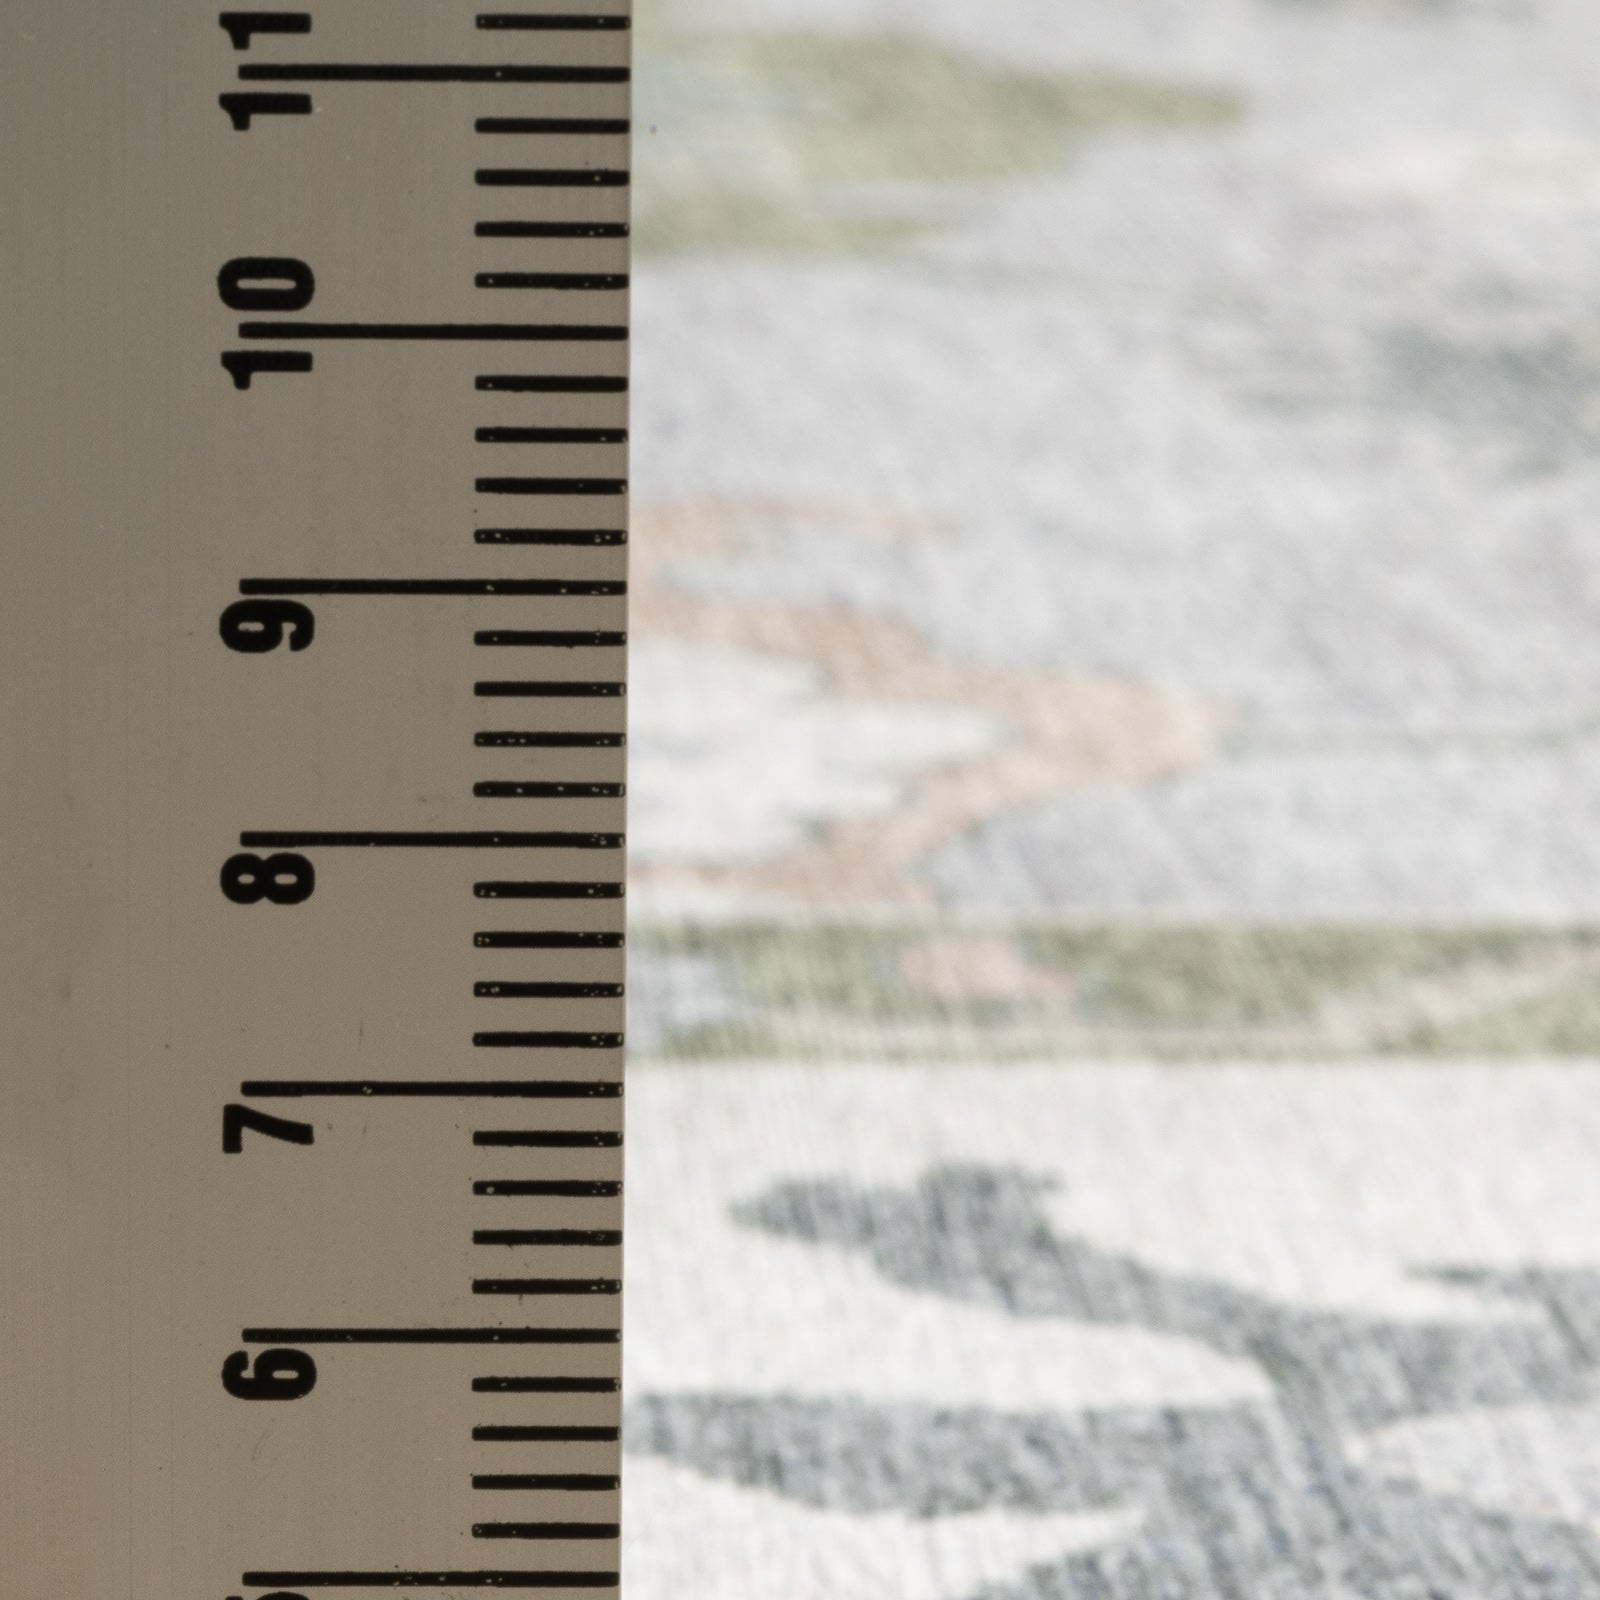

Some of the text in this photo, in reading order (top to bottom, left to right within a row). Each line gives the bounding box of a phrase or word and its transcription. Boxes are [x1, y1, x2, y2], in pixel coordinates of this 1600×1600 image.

[219, 12, 313, 131] 11
[217, 257, 315, 390] 10
[220, 599, 314, 653] 9
[220, 853, 315, 905] 8
[223, 1104, 314, 1153] 7
[222, 1349, 316, 1400] 6
